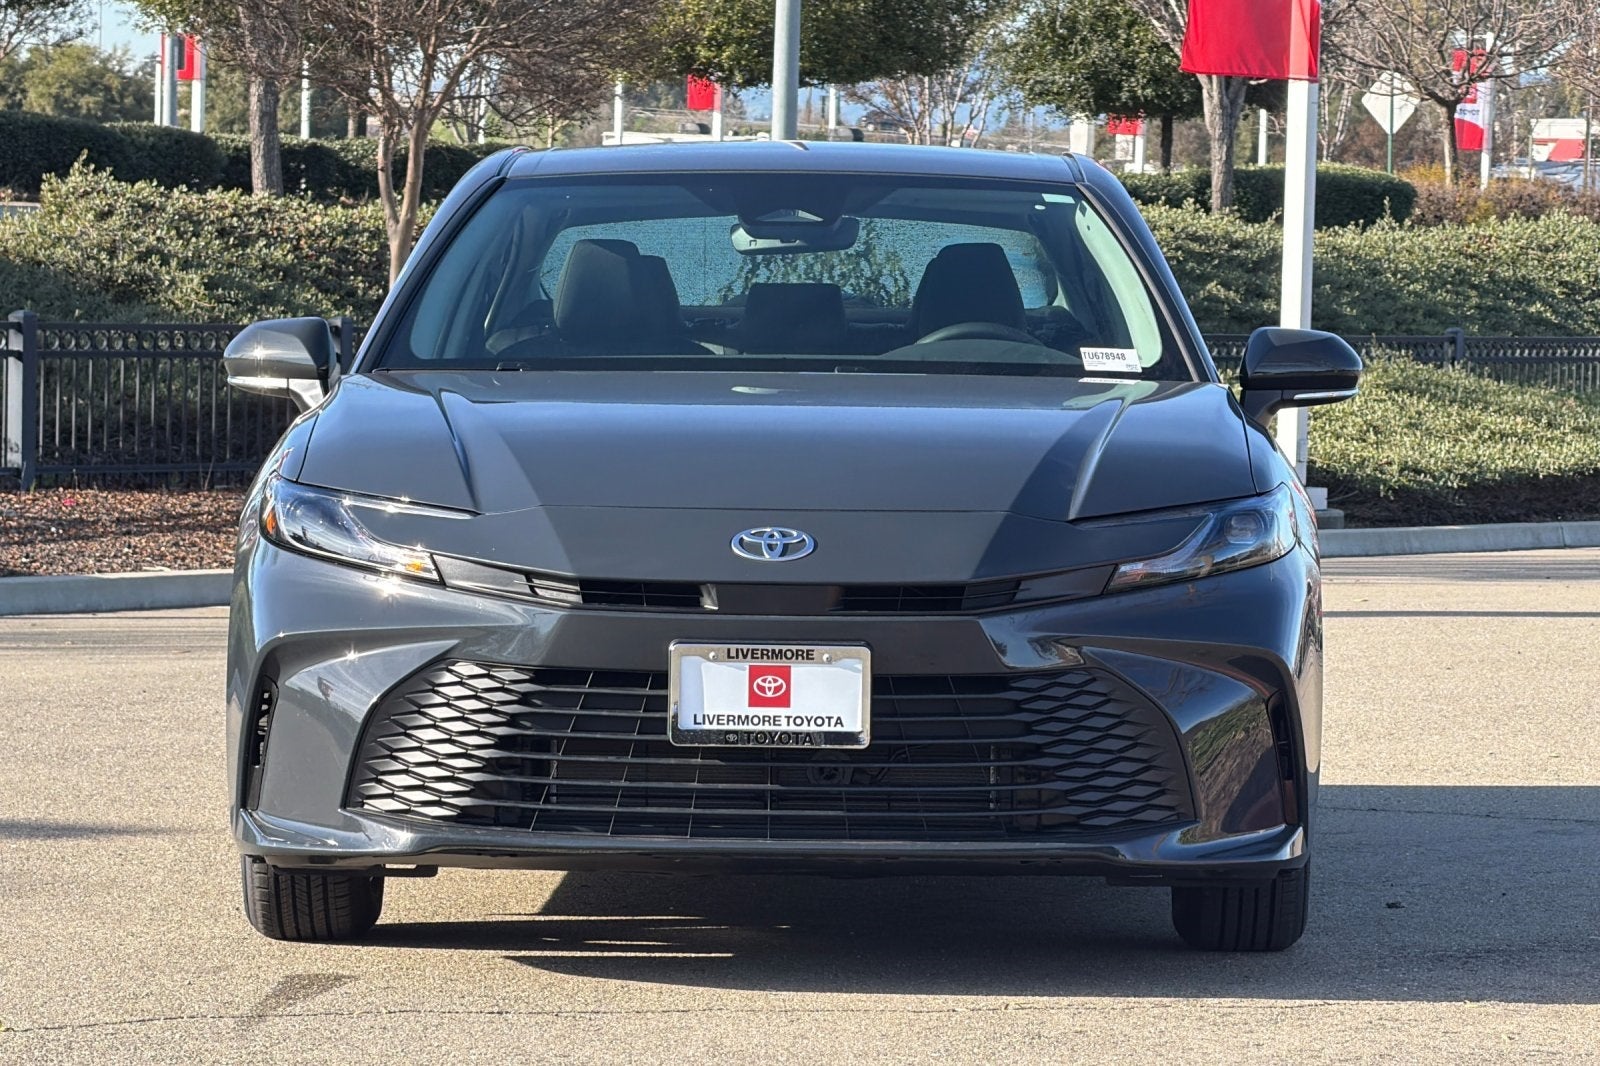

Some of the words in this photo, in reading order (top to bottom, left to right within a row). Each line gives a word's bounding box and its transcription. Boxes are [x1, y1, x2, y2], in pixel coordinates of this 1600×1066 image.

[1082, 352, 1127, 361] TU678948
[726, 648, 815, 661] LIVERMORE
[693, 713, 782, 727] LIVERMORE
[784, 715, 844, 728] TOYOTA
[745, 731, 815, 746] TOYOTA
